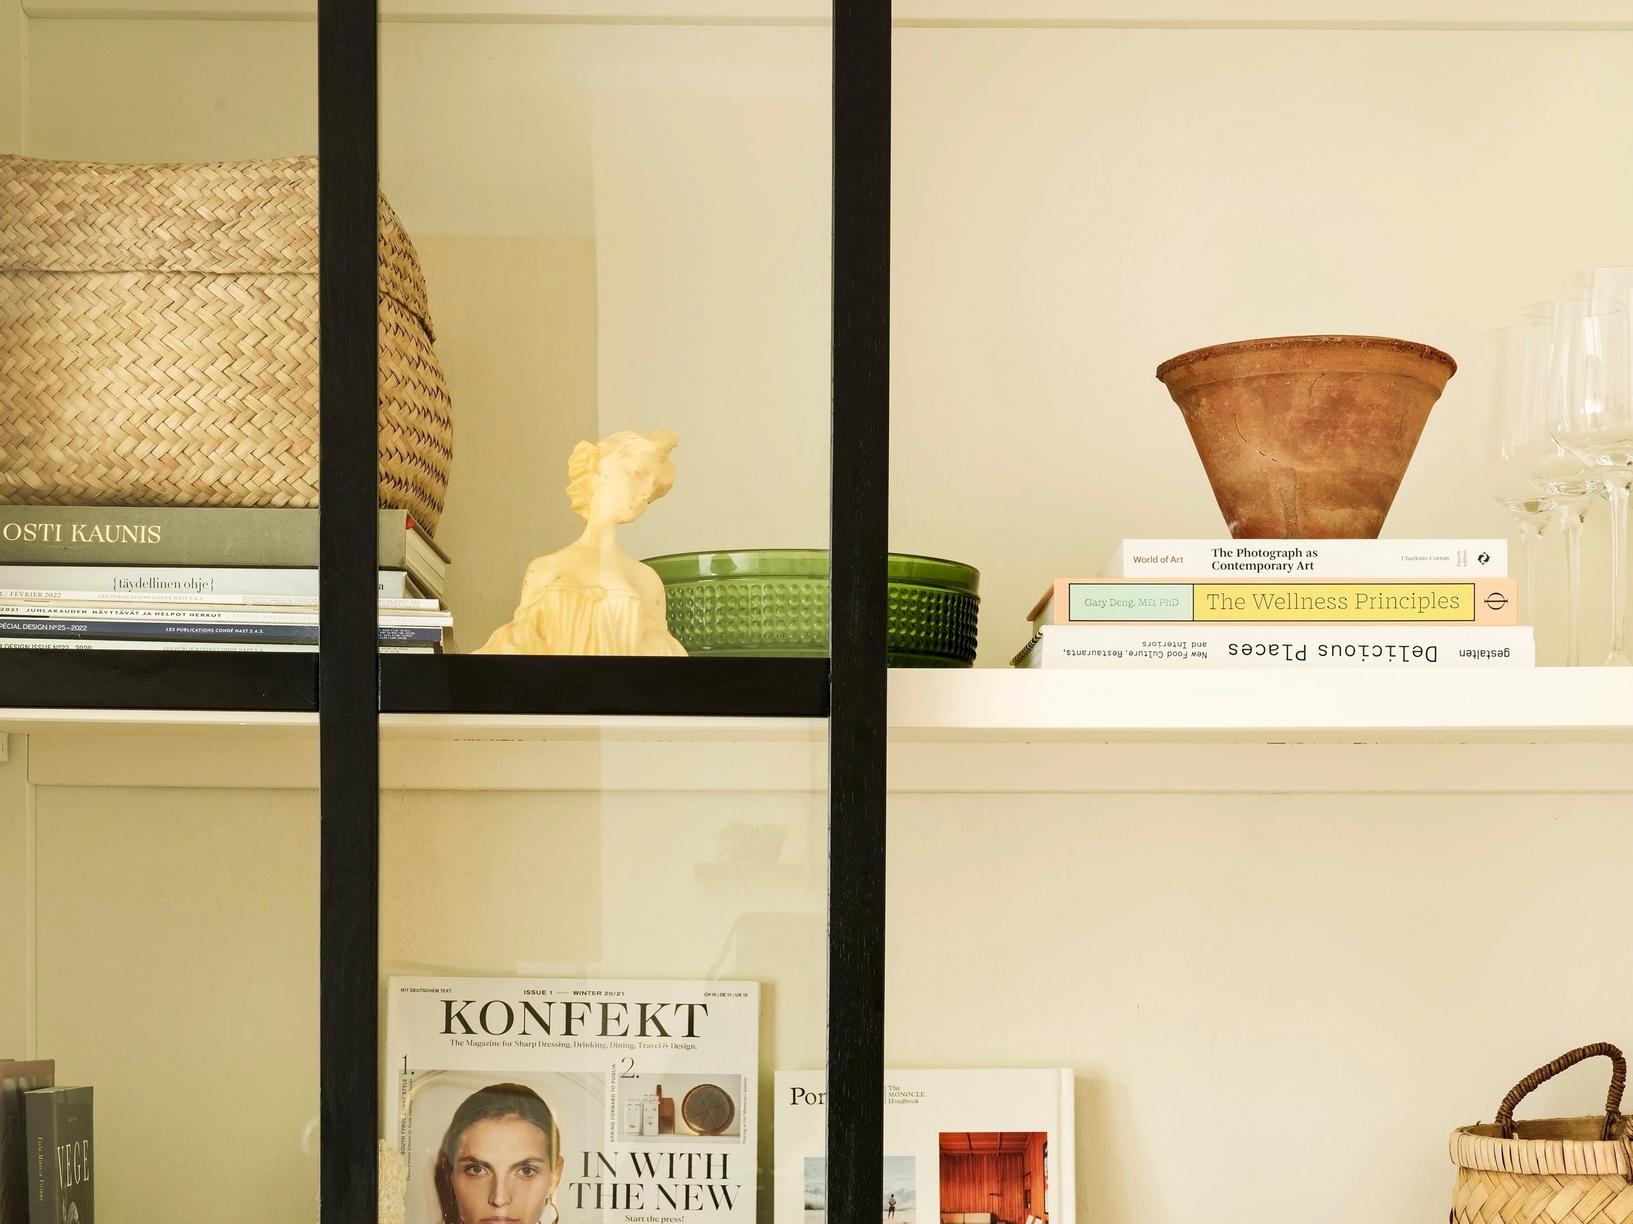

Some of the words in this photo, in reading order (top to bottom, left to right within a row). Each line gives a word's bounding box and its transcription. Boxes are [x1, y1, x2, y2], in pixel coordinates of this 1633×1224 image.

[71, 522, 162, 544] KAUNIS
[1132, 555, 1159, 564] World
[1159, 555, 1169, 564] of
[1170, 555, 1184, 564] Art
[1211, 547, 1234, 558] The
[1236, 547, 1301, 561] Photograph
[1305, 550, 1319, 558] as
[1211, 561, 1294, 573] Contemporary
[1296, 560, 1314, 571] Art
[1083, 598, 1108, 609] Gary
[1108, 598, 1137, 609] Deng,
[1157, 597, 1180, 608] PhD
[1206, 592, 1246, 611] The
[1251, 592, 1348, 611] Wellness
[1354, 591, 1460, 614] Principles
[92, 608, 140, 616] NÄYTTÄVÄT
[22, 623, 48, 631] DESIGN
[70, 624, 88, 632] 2022
[1141, 640, 1188, 650] Interiors
[1191, 641, 1208, 650] and
[1063, 650, 1123, 659] Restaurants,
[1166, 650, 1189, 660] Food
[1190, 650, 1208, 659] New
[1228, 643, 1307, 662] Places
[1318, 644, 1438, 663] Delicious
[1458, 647, 1511, 660] gestalten
[439, 999, 709, 1038] KONFEKT
[449, 1039, 467, 1047] The
[465, 1039, 501, 1048] Magazine
[502, 1039, 514, 1047] for
[514, 1039, 537, 1049] Sharp
[637, 1041, 663, 1049] Travel
[670, 1042, 698, 1051] Design.
[887, 1090, 926, 1098] MONOCLE
[56, 1139, 90, 1190] VEGE
[581, 1151, 618, 1178] IN
[629, 1151, 729, 1180] WITH
[568, 1182, 645, 1210] THE
[656, 1184, 741, 1211] NEW
[624, 1215, 645, 1224] Start
[647, 1215, 662, 1224] the
